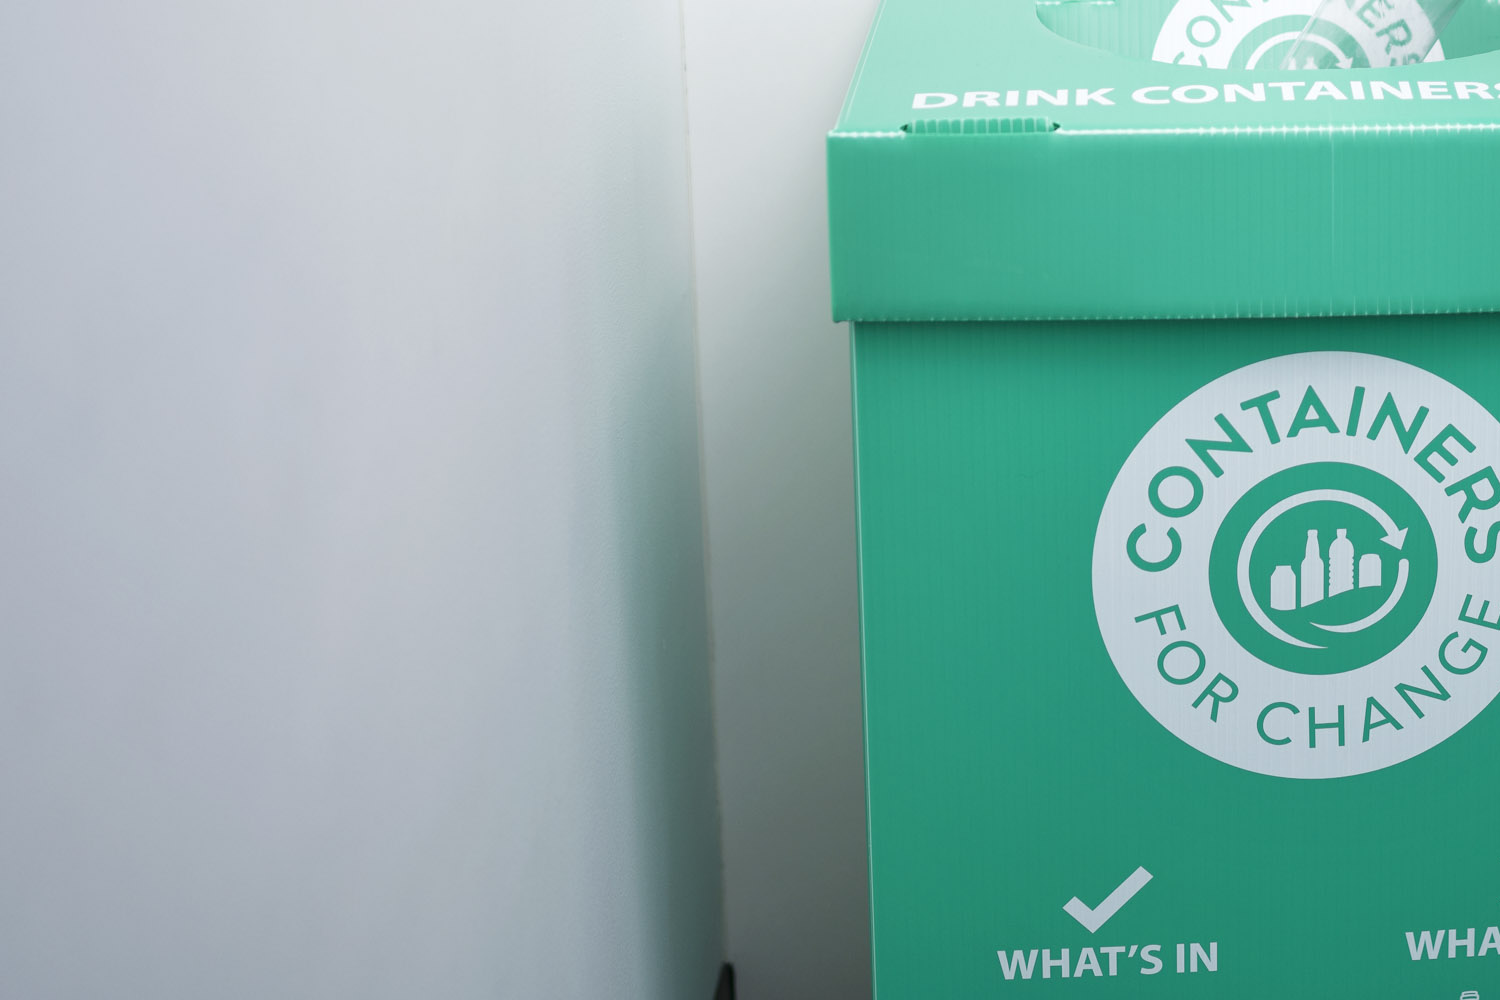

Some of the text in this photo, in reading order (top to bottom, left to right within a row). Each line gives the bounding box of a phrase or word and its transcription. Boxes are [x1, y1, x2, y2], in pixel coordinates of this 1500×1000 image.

[912, 88, 1116, 109] DRINK
[1135, 605, 1238, 722] FOR
[997, 942, 1218, 979] WHAT'S IN
